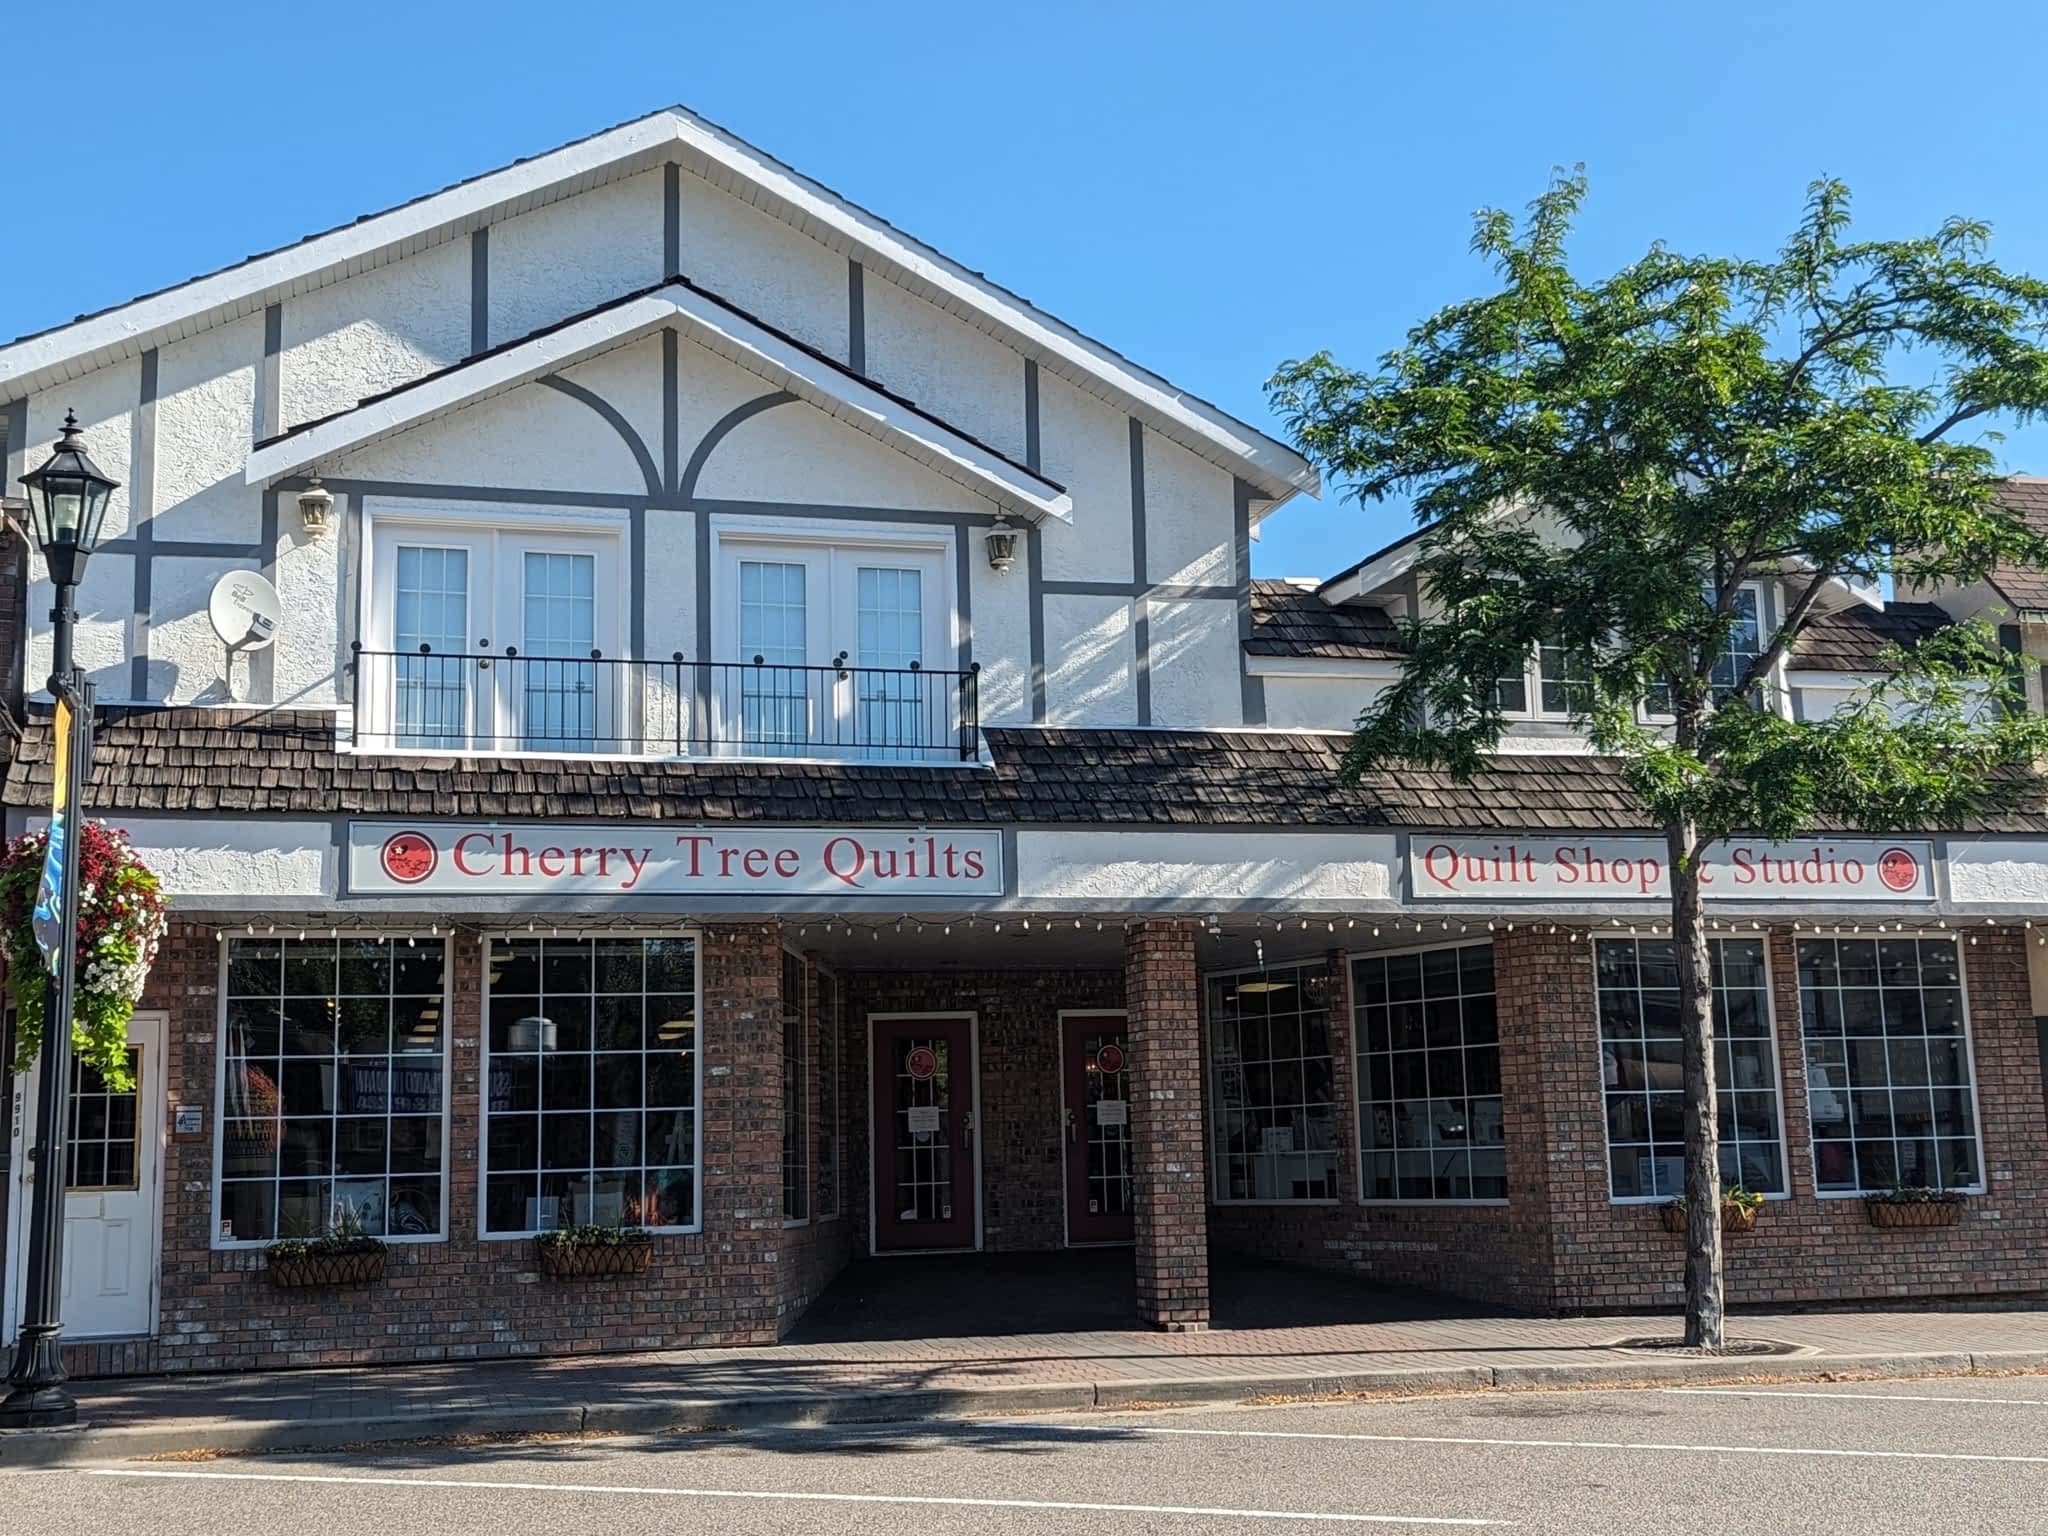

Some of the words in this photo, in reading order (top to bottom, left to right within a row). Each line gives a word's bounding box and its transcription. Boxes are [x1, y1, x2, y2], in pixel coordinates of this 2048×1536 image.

[453, 832, 653, 889] Cherry
[676, 836, 800, 878] Tree
[823, 836, 985, 889] Quilts
[1424, 844, 1537, 892] Quilt
[1554, 846, 1661, 894] Shop
[1732, 847, 1864, 885] Studio
